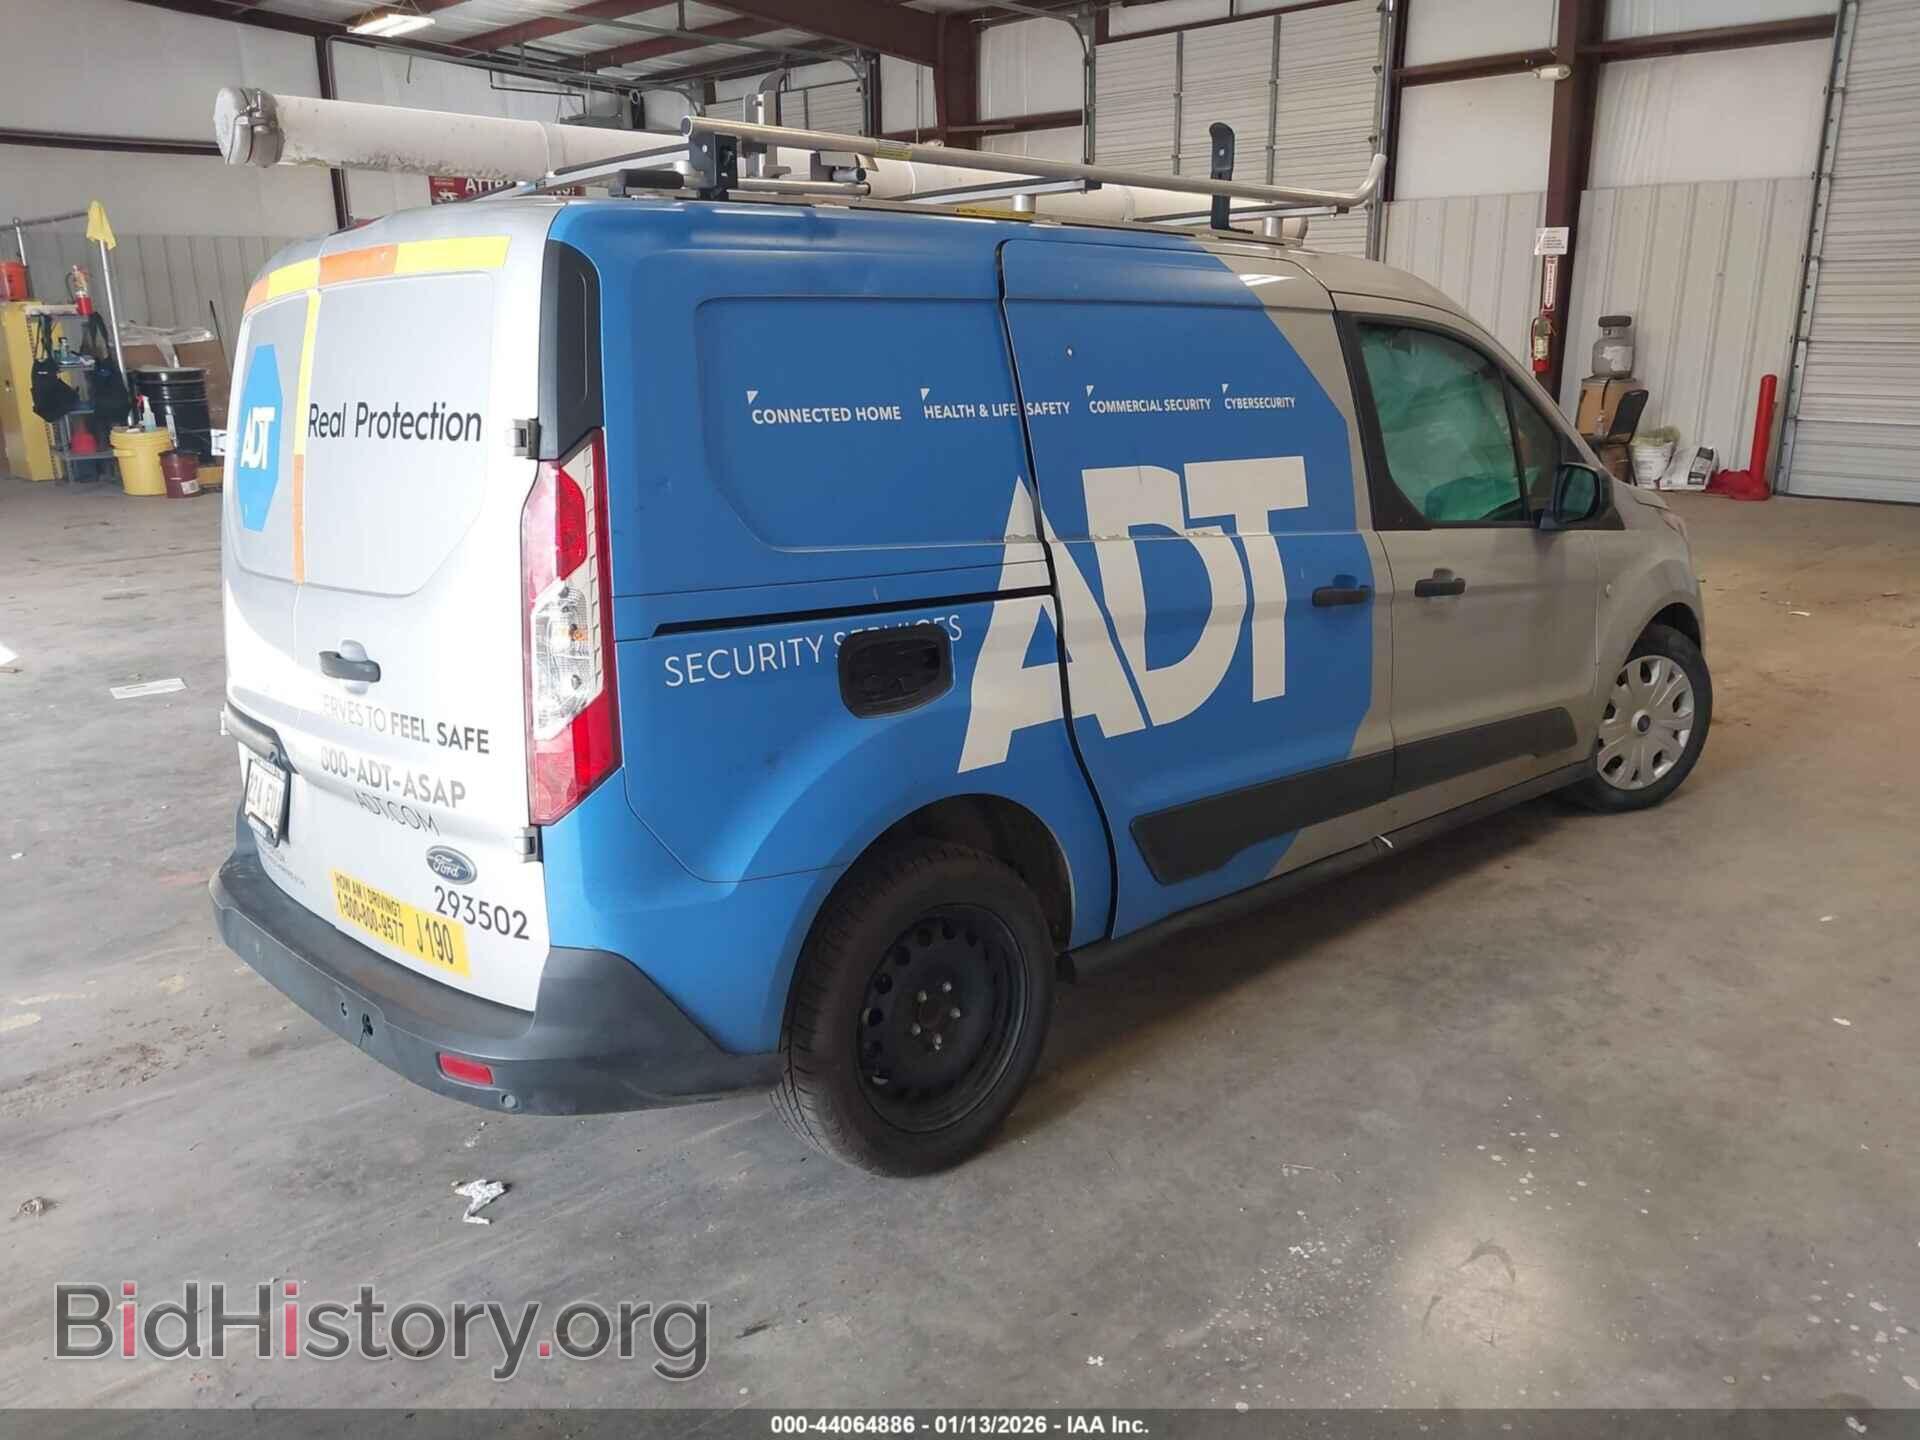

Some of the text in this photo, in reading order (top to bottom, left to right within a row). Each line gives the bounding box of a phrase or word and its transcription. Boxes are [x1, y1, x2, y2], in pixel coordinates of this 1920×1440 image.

[308, 401, 482, 441] Real Protection
[752, 405, 902, 425] CONNECTED HOME
[924, 401, 1072, 419] HEALTH & LIFE SAFETY
[1089, 398, 1211, 414] COMMERCIAL SECURITY
[1224, 397, 1296, 410] CYBERSECURITY
[240, 406, 276, 470] ADT
[957, 456, 1309, 773] ADT
[664, 633, 824, 687] SECURITY
[366, 705, 386, 732] TO
[390, 711, 430, 744] FEEL
[437, 722, 490, 754] SAFE
[434, 885, 530, 940] 293502
[425, 917, 454, 965] 190
